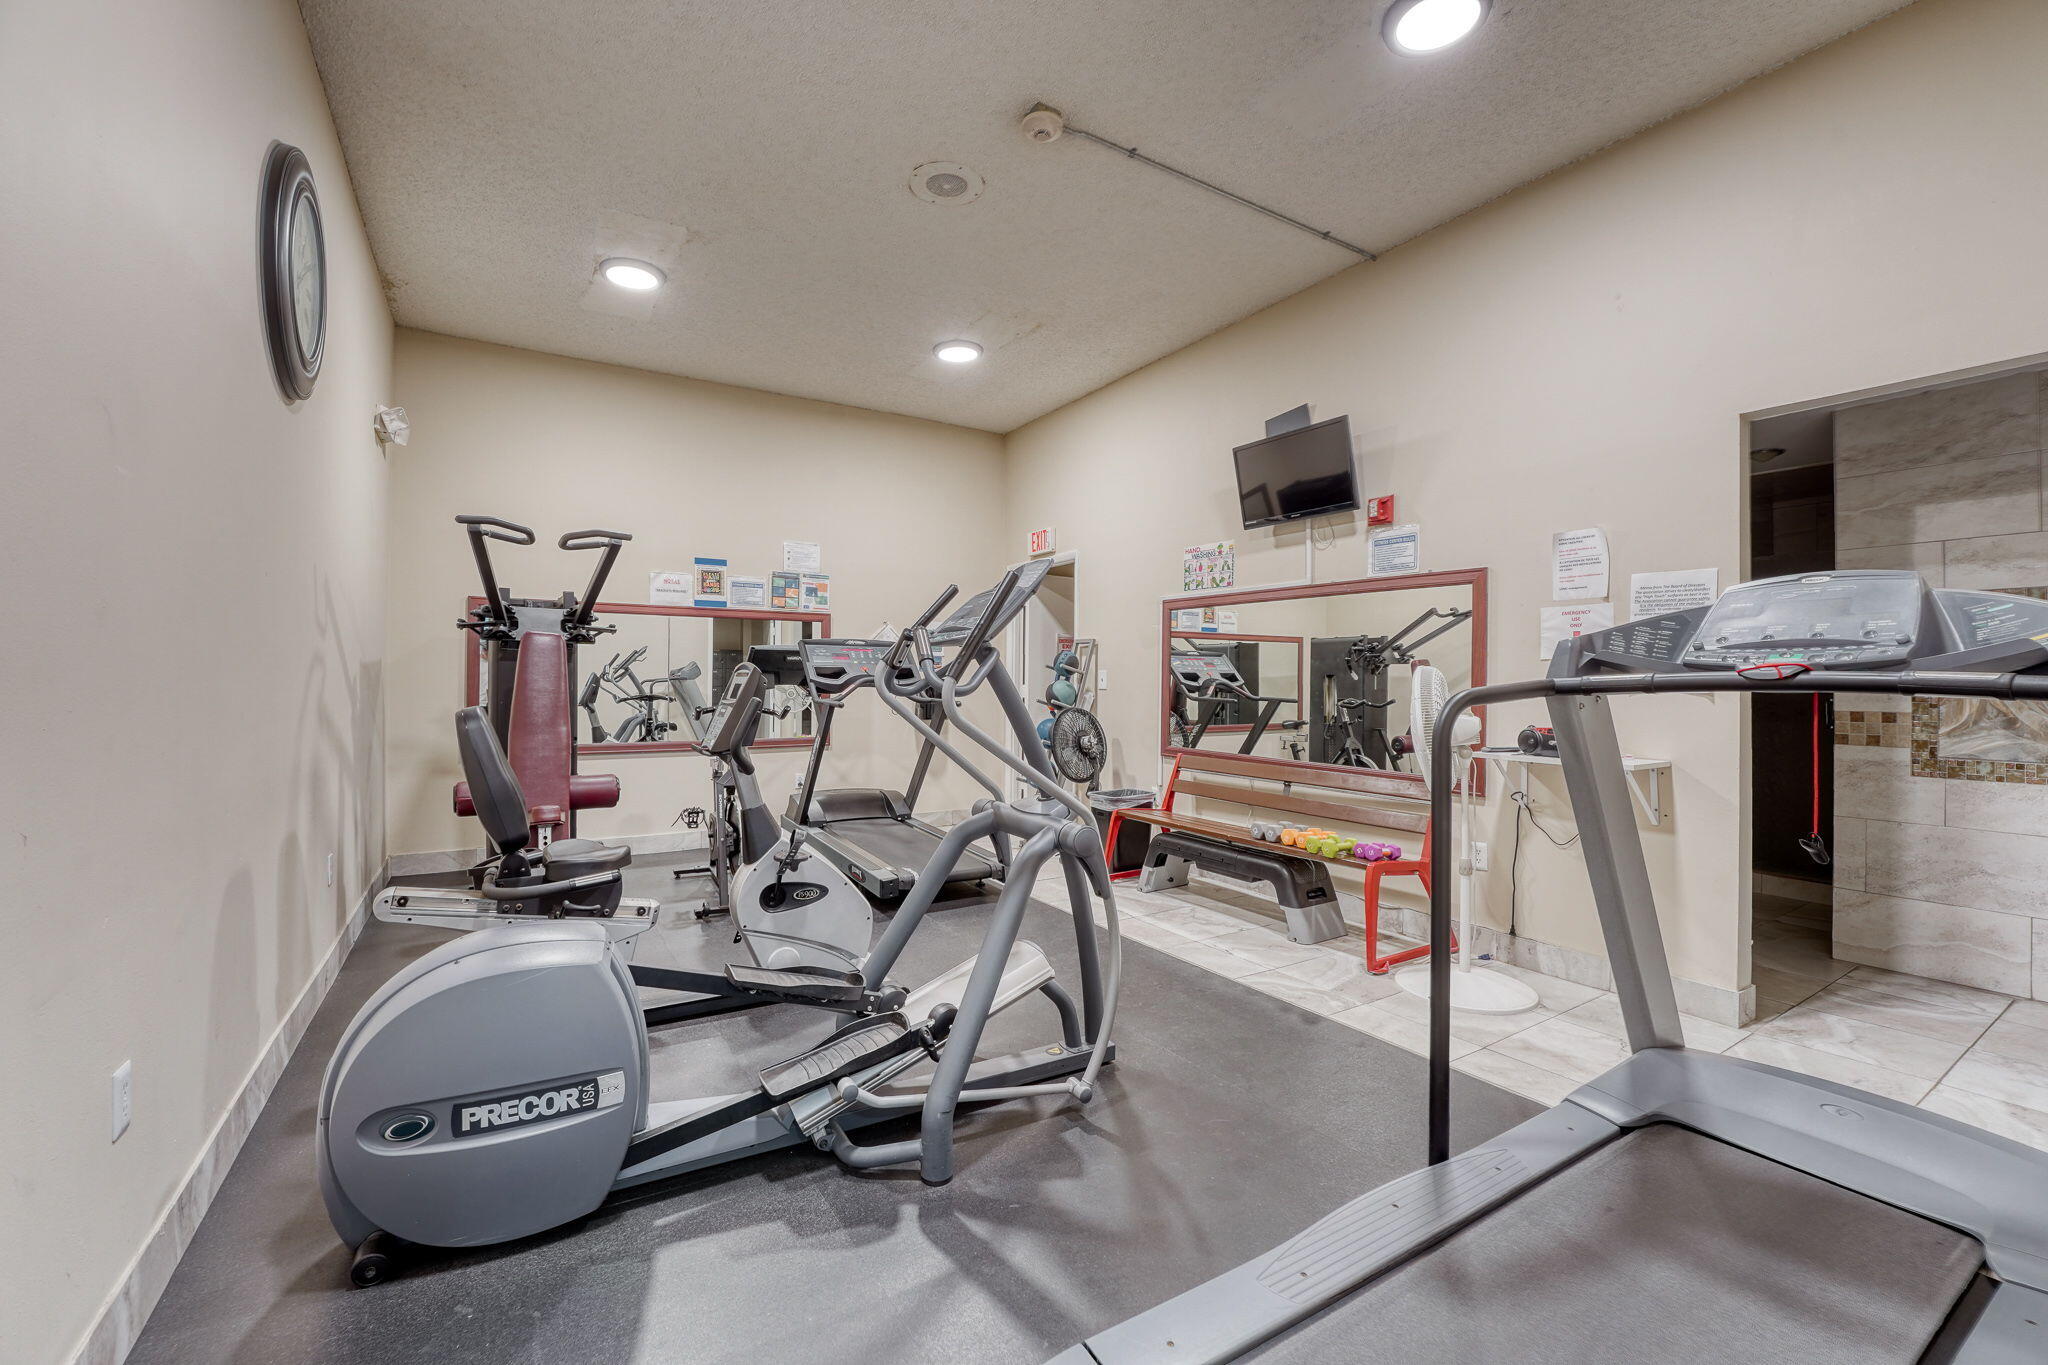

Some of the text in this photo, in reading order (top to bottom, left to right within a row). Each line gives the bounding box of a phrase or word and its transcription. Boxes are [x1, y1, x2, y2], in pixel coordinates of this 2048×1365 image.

[1031, 530, 1047, 552] EXIT
[1191, 551, 1216, 560] WASHING
[582, 1083, 595, 1107] USA
[601, 1084, 620, 1095] EFX
[461, 1087, 581, 1131] PRECOR
